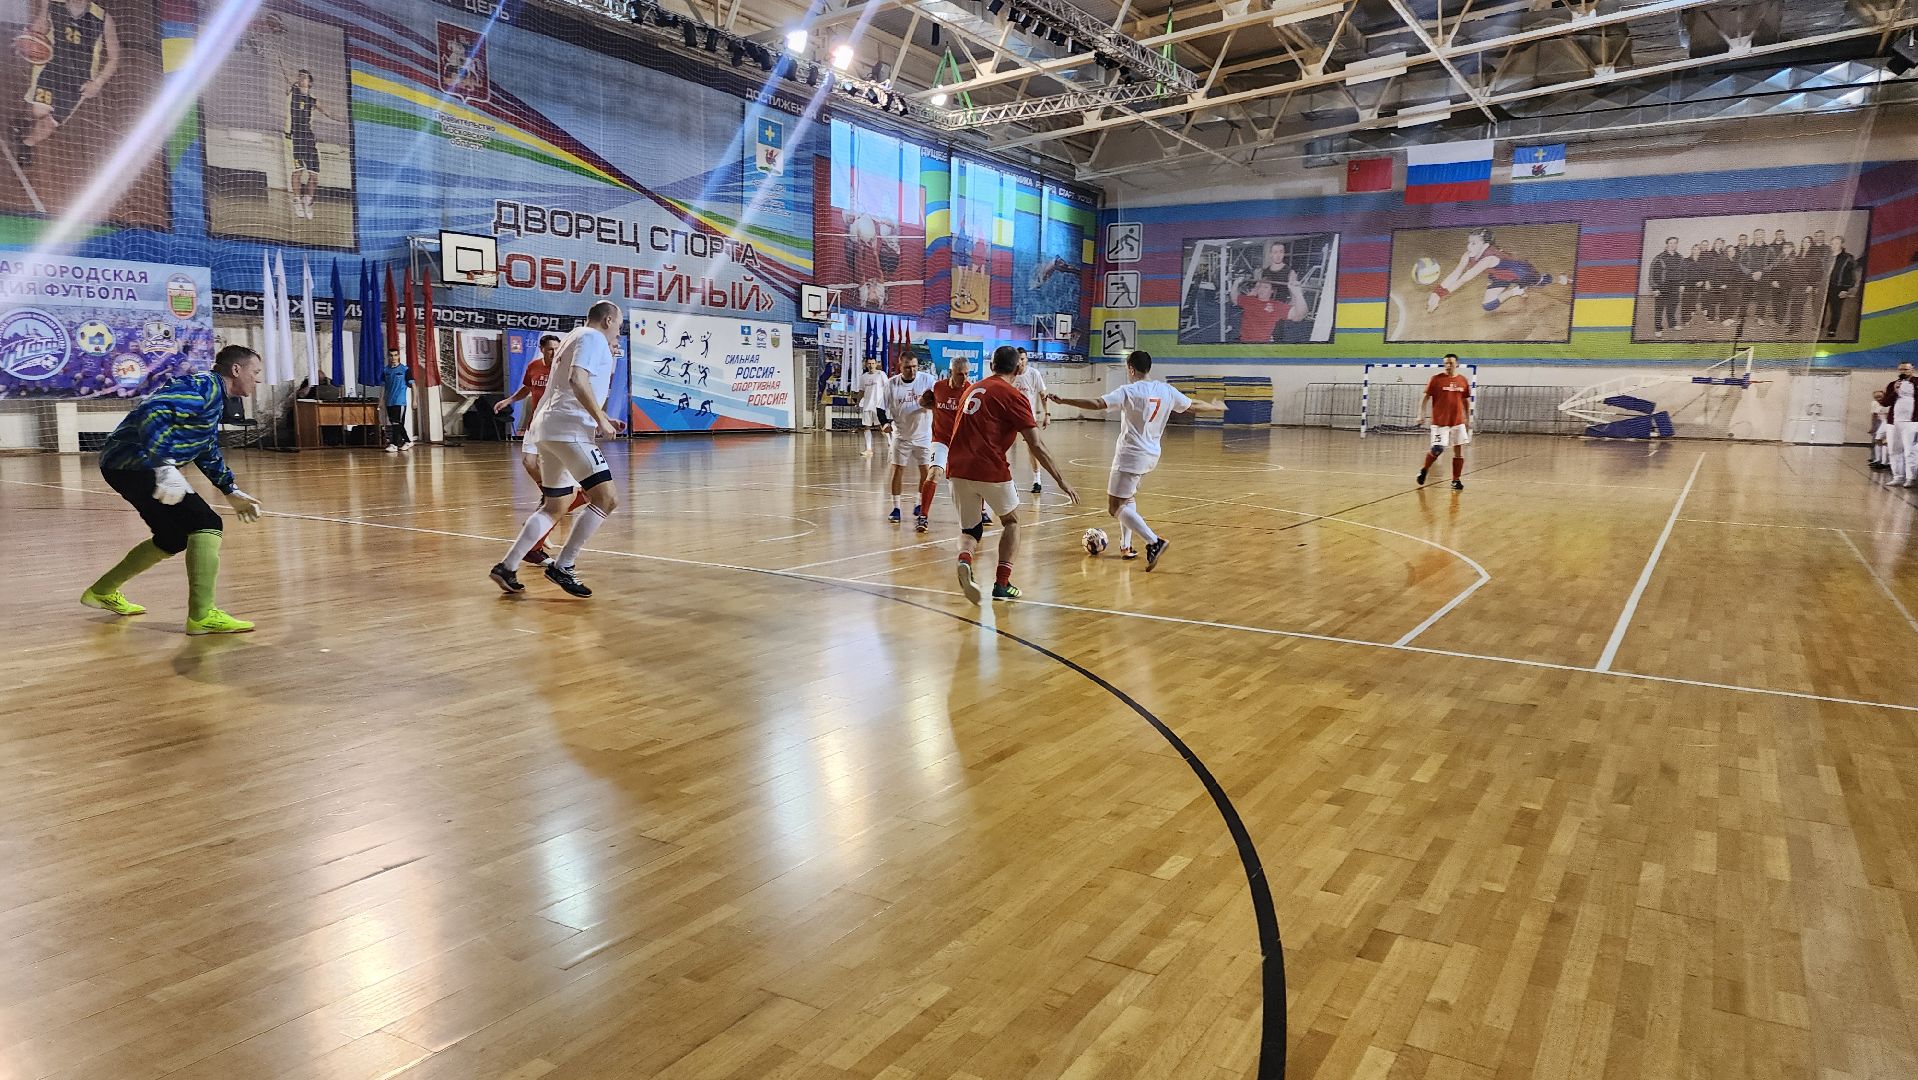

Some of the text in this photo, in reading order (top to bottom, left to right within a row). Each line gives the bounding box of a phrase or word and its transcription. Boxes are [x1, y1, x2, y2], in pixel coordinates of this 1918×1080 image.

[492, 199, 760, 267] ДВОРЕЦ СПОРТА
[33, 264, 148, 284] ГОРОДСКАЯ
[45, 284, 138, 302] ФУТБОЛА
[496, 313, 559, 330] РЕКОРД
[725, 354, 760, 365] СИЛЬНАЯ
[735, 366, 775, 379] РОССИЯ
[731, 380, 781, 392] СПОРТИВНАЯ
[747, 392, 788, 407] РОССИЯ!
[963, 387, 986, 415] 6
[1149, 398, 1161, 422] 7
